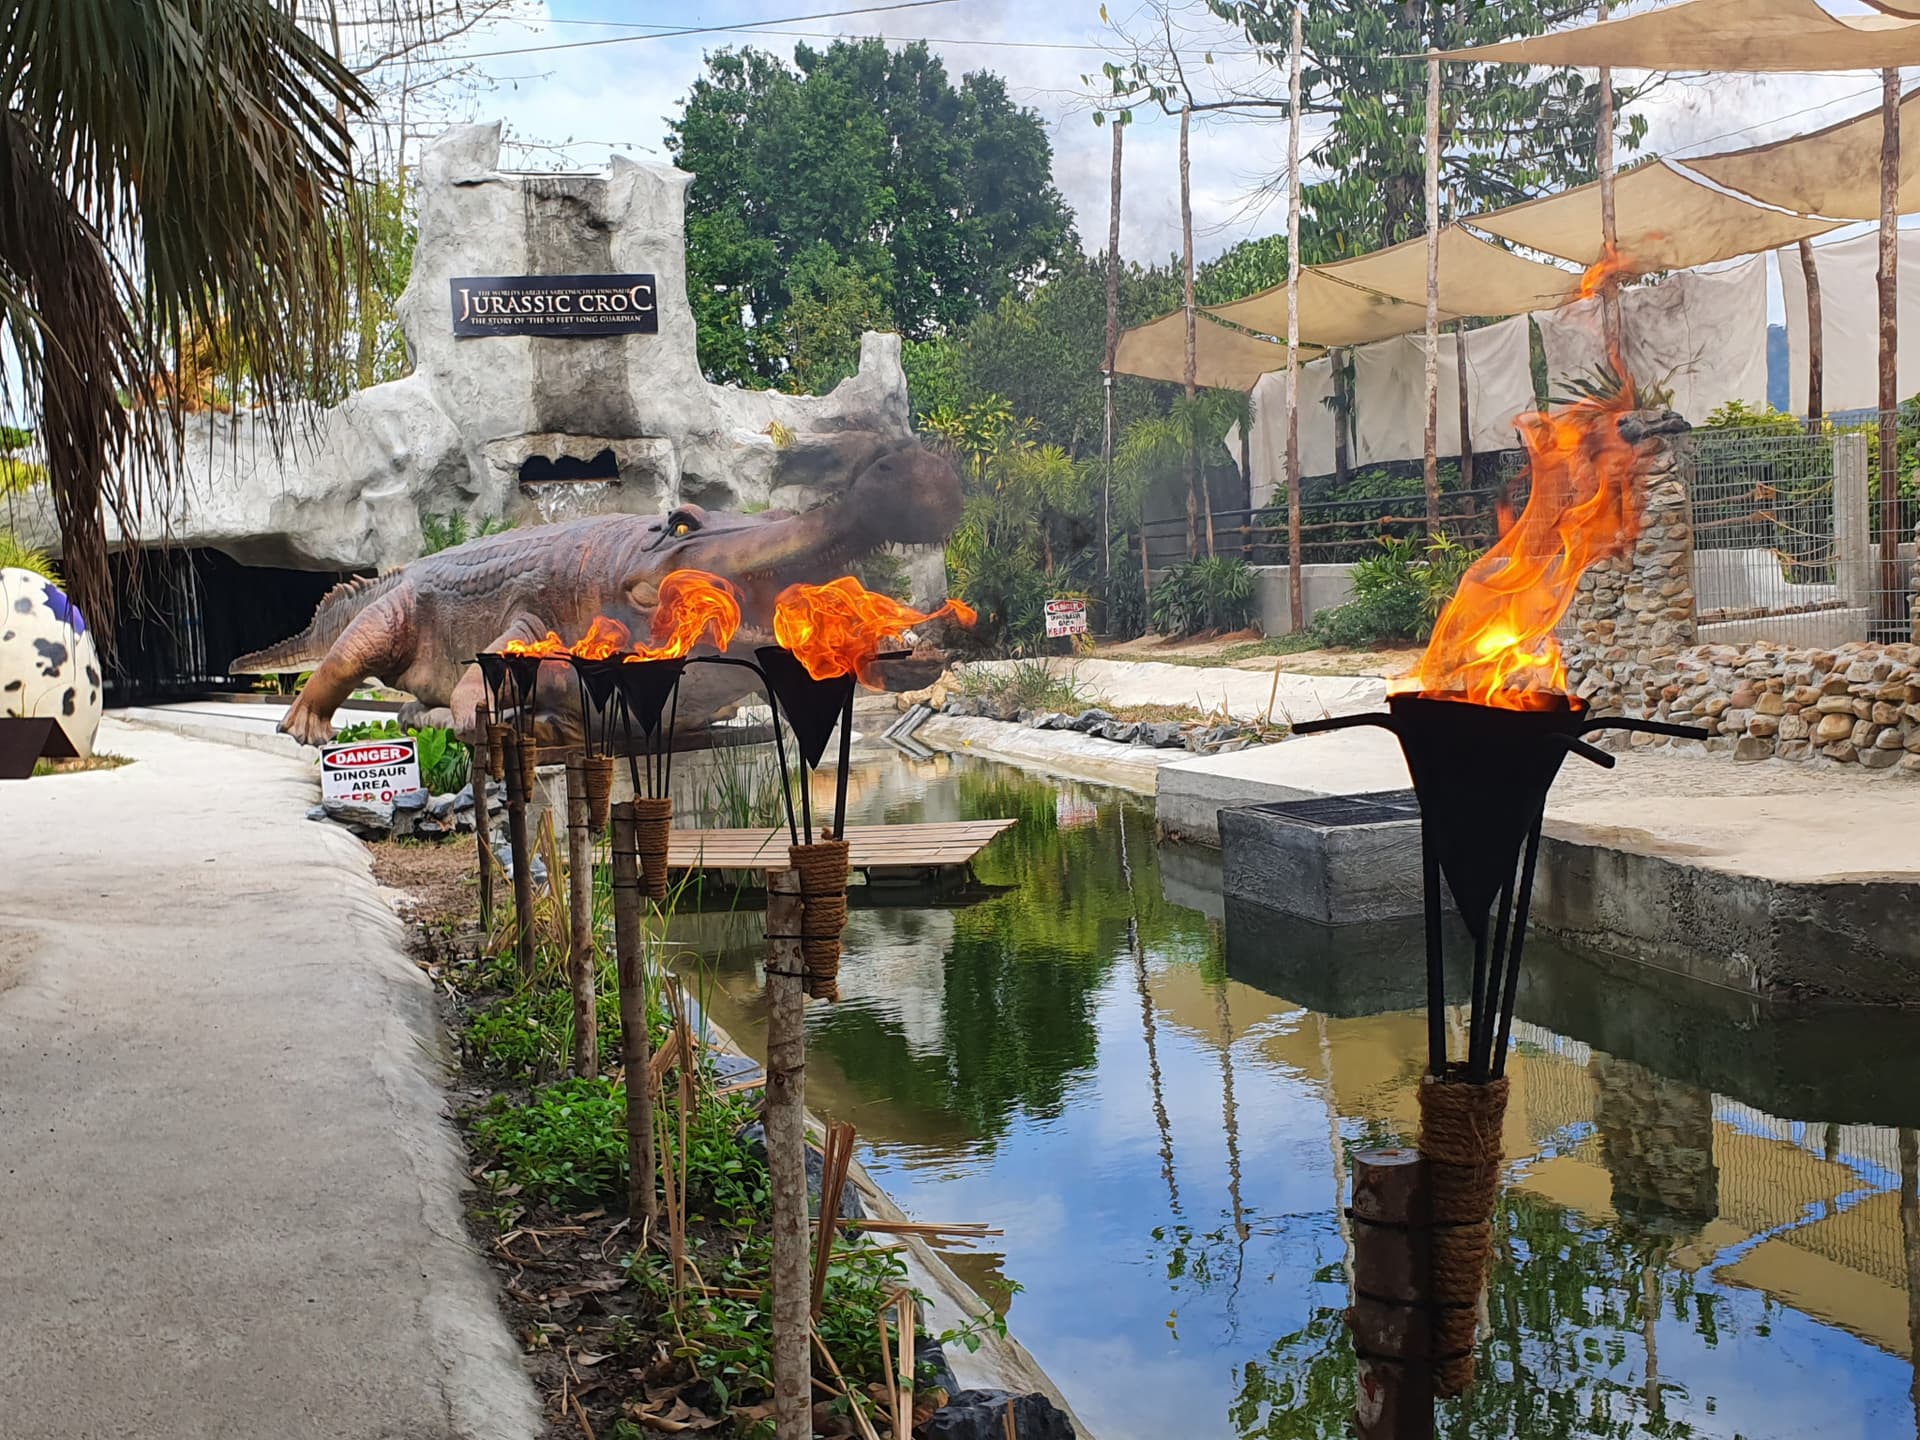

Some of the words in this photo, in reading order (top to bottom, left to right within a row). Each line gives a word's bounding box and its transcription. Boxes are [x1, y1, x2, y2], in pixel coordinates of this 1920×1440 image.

[459, 288, 571, 322] JURASSIC
[579, 285, 655, 313] CROC
[471, 317, 486, 325] THE
[487, 317, 513, 325] STORY
[514, 317, 525, 325] OF
[556, 316, 574, 324] FEET
[575, 315, 599, 323] LONG
[335, 748, 401, 764] DANGER
[333, 766, 407, 782] DINOSAUR
[352, 779, 391, 791] AREA
